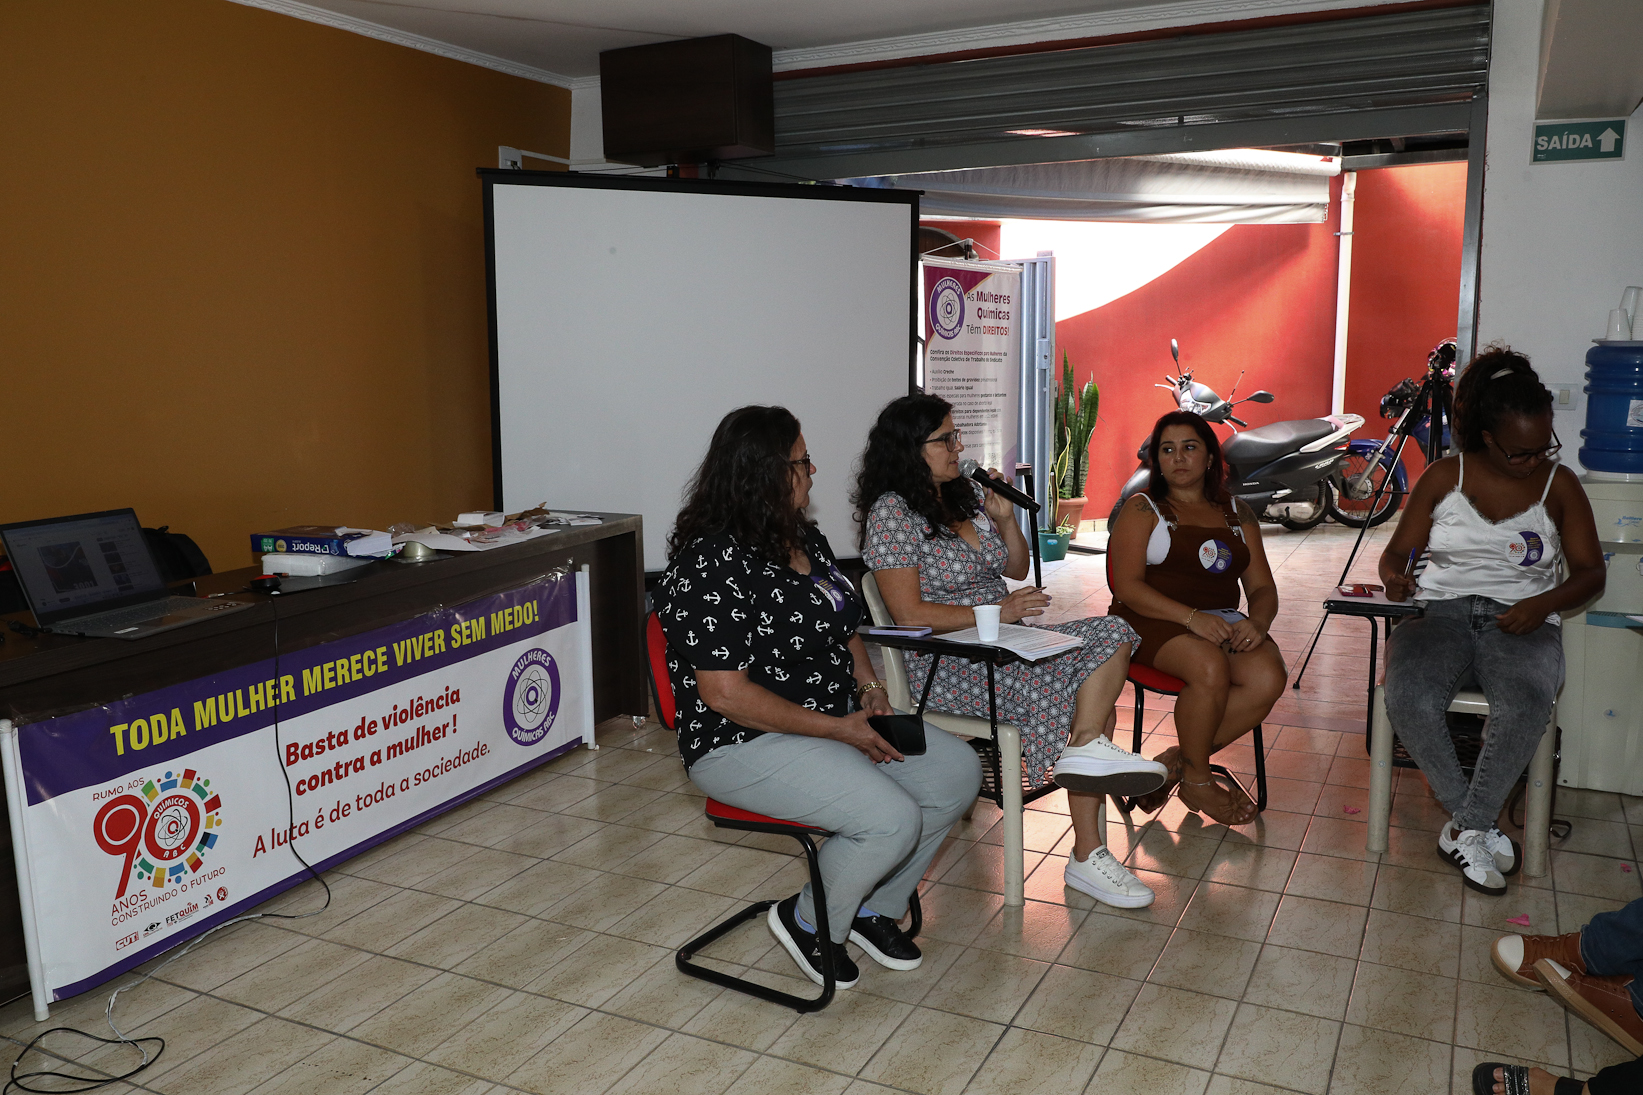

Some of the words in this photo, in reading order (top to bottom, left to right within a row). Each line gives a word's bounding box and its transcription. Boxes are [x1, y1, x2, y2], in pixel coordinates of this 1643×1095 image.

[1537, 131, 1593, 150] SAÍDA
[966, 292, 975, 302] As
[976, 291, 1011, 305] Mulheres
[977, 307, 1010, 321] Químicas
[966, 324, 981, 335] Têm
[982, 325, 1010, 336] DIREITOS!
[292, 542, 321, 553] Report
[109, 707, 187, 756] TODA
[193, 674, 296, 731] MULHER
[302, 646, 388, 697] MERECE
[393, 629, 446, 666] VIVER
[450, 616, 486, 648] SEM
[490, 600, 539, 636] MEDO!
[512, 650, 551, 680] MULHERES
[285, 729, 349, 767] Basta
[353, 716, 378, 741] de
[381, 685, 461, 731] violência
[512, 726, 544, 742] QUÍMICAS
[543, 711, 555, 731] ABC
[295, 755, 365, 797] contra
[369, 749, 382, 767] a
[386, 722, 450, 761] mulher
[92, 785, 123, 802] RUMO
[127, 777, 145, 791] AOS
[252, 835, 267, 858] A
[271, 821, 310, 850] luta
[314, 808, 324, 829] é
[329, 801, 351, 823] de
[356, 781, 396, 812] toda
[399, 777, 410, 793] a
[413, 741, 491, 787] sociedade.
[153, 797, 190, 820] QUÍMICOS
[111, 888, 178, 927] CONSTRUINDO
[180, 883, 188, 893] O
[190, 866, 226, 889] FUTURO
[111, 889, 148, 917] ANOS
[115, 931, 138, 951] CUT
